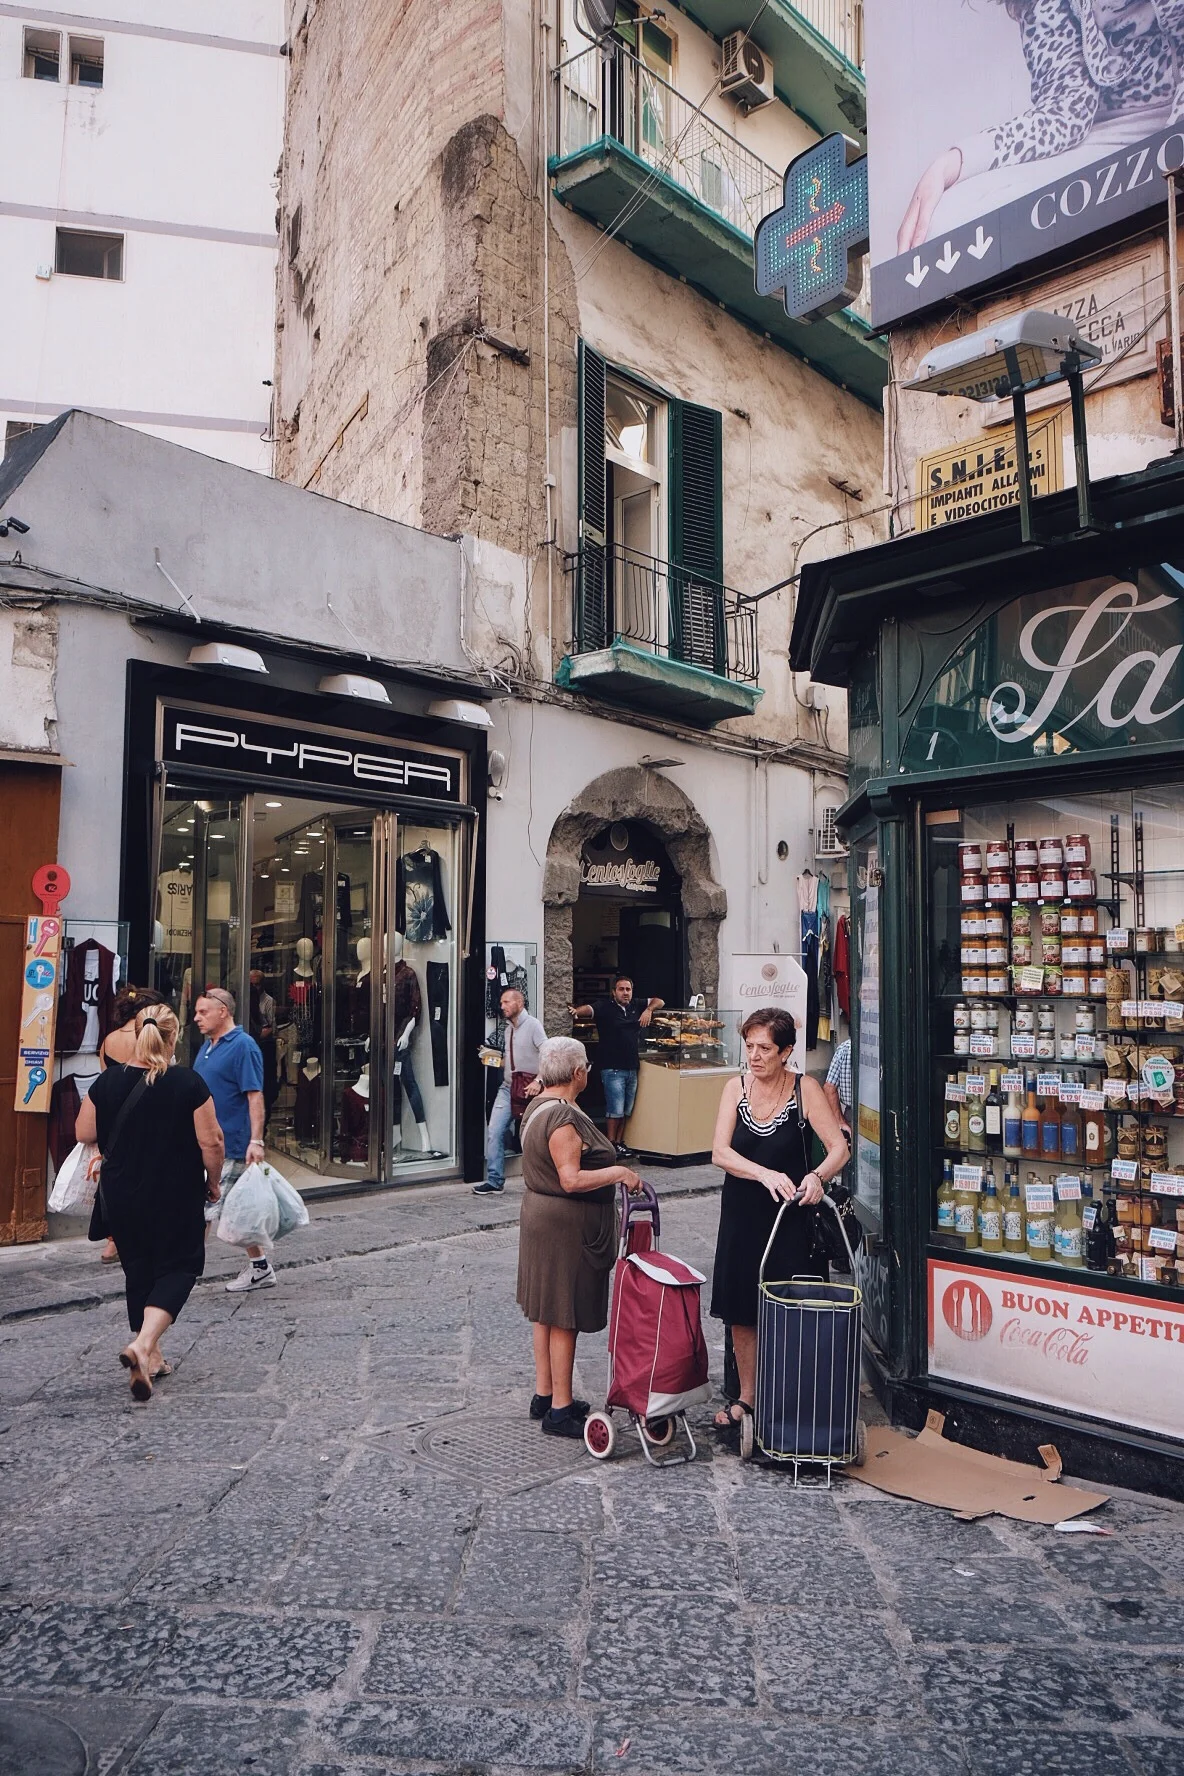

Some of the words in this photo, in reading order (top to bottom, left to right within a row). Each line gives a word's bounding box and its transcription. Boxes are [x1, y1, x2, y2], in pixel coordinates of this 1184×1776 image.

[1031, 133, 1184, 229] COZZO
[930, 513, 937, 527] E
[945, 484, 1038, 521] VIDEOCITOFOI
[931, 482, 983, 509] IMPIANTI
[992, 463, 1045, 491] ALLAMI
[176, 723, 450, 791] PYPER
[739, 981, 800, 997] Centosfoglie
[1002, 1290, 1069, 1320] BUON
